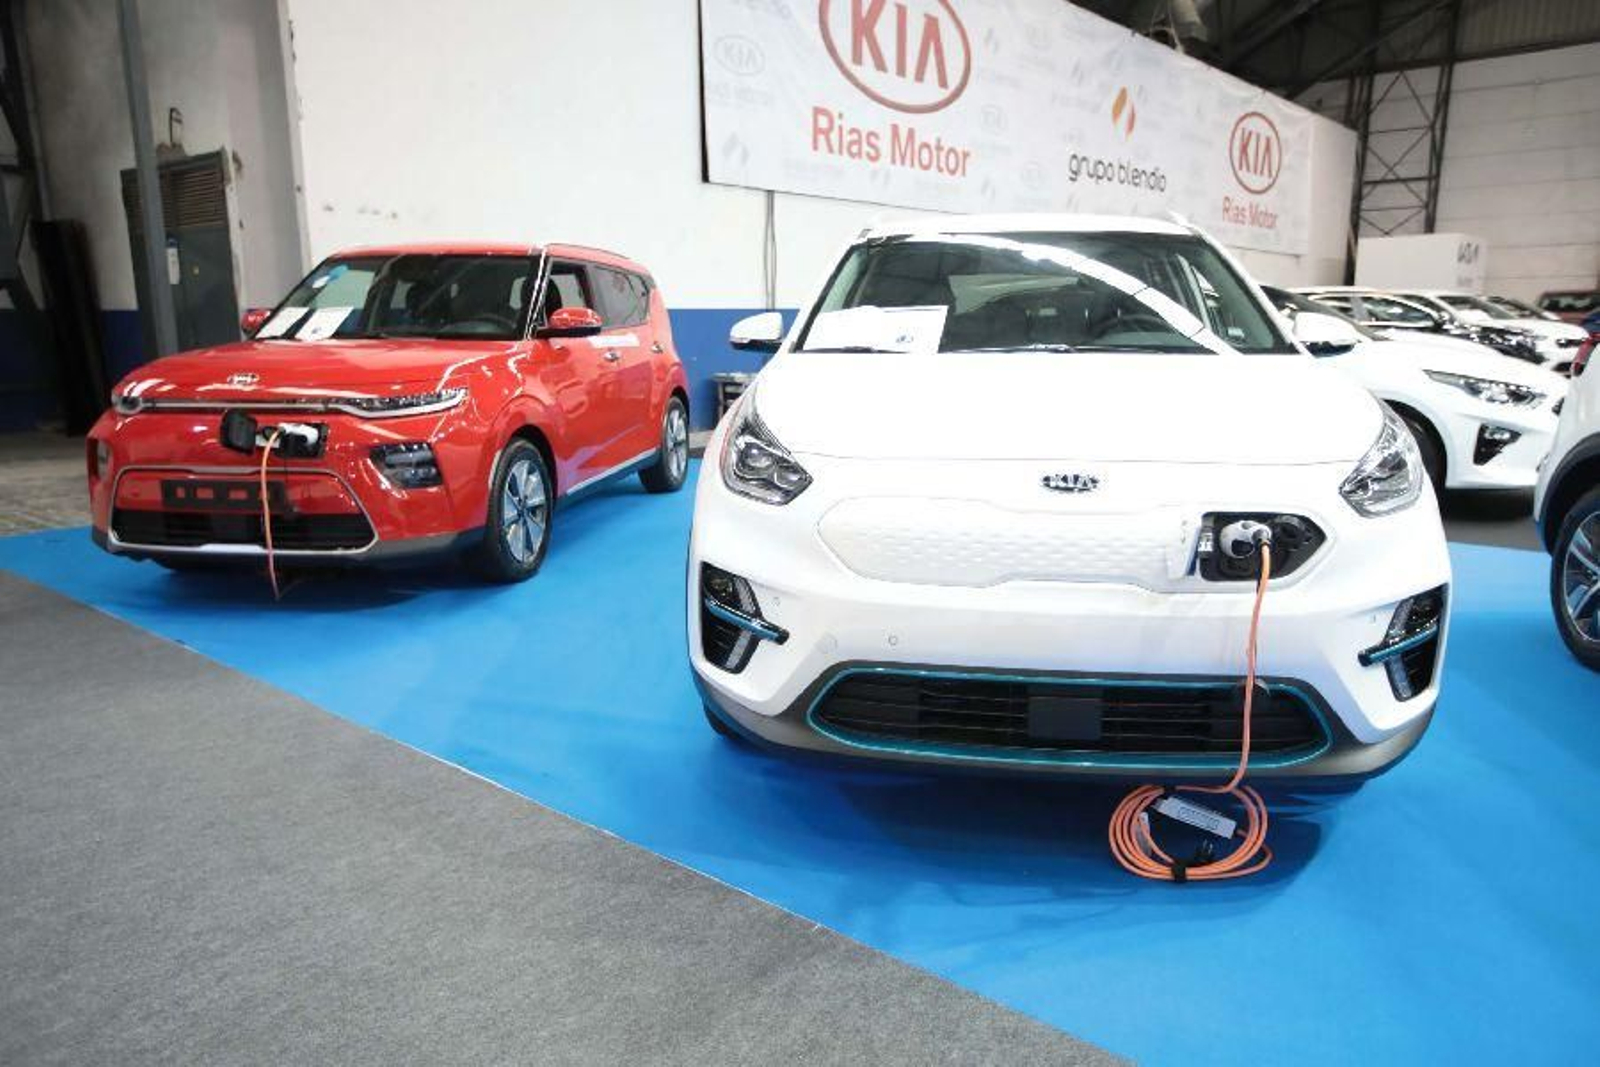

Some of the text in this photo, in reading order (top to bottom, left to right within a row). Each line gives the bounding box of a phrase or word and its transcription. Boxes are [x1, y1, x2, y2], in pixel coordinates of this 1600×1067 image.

[850, 0, 949, 90] KIA
[811, 106, 882, 163] Rias
[890, 123, 970, 177] Motor
[1238, 126, 1274, 179] KIA
[1068, 153, 1114, 183] grupo
[1117, 157, 1168, 193] blendio
[1222, 196, 1279, 229] Rias Motor
